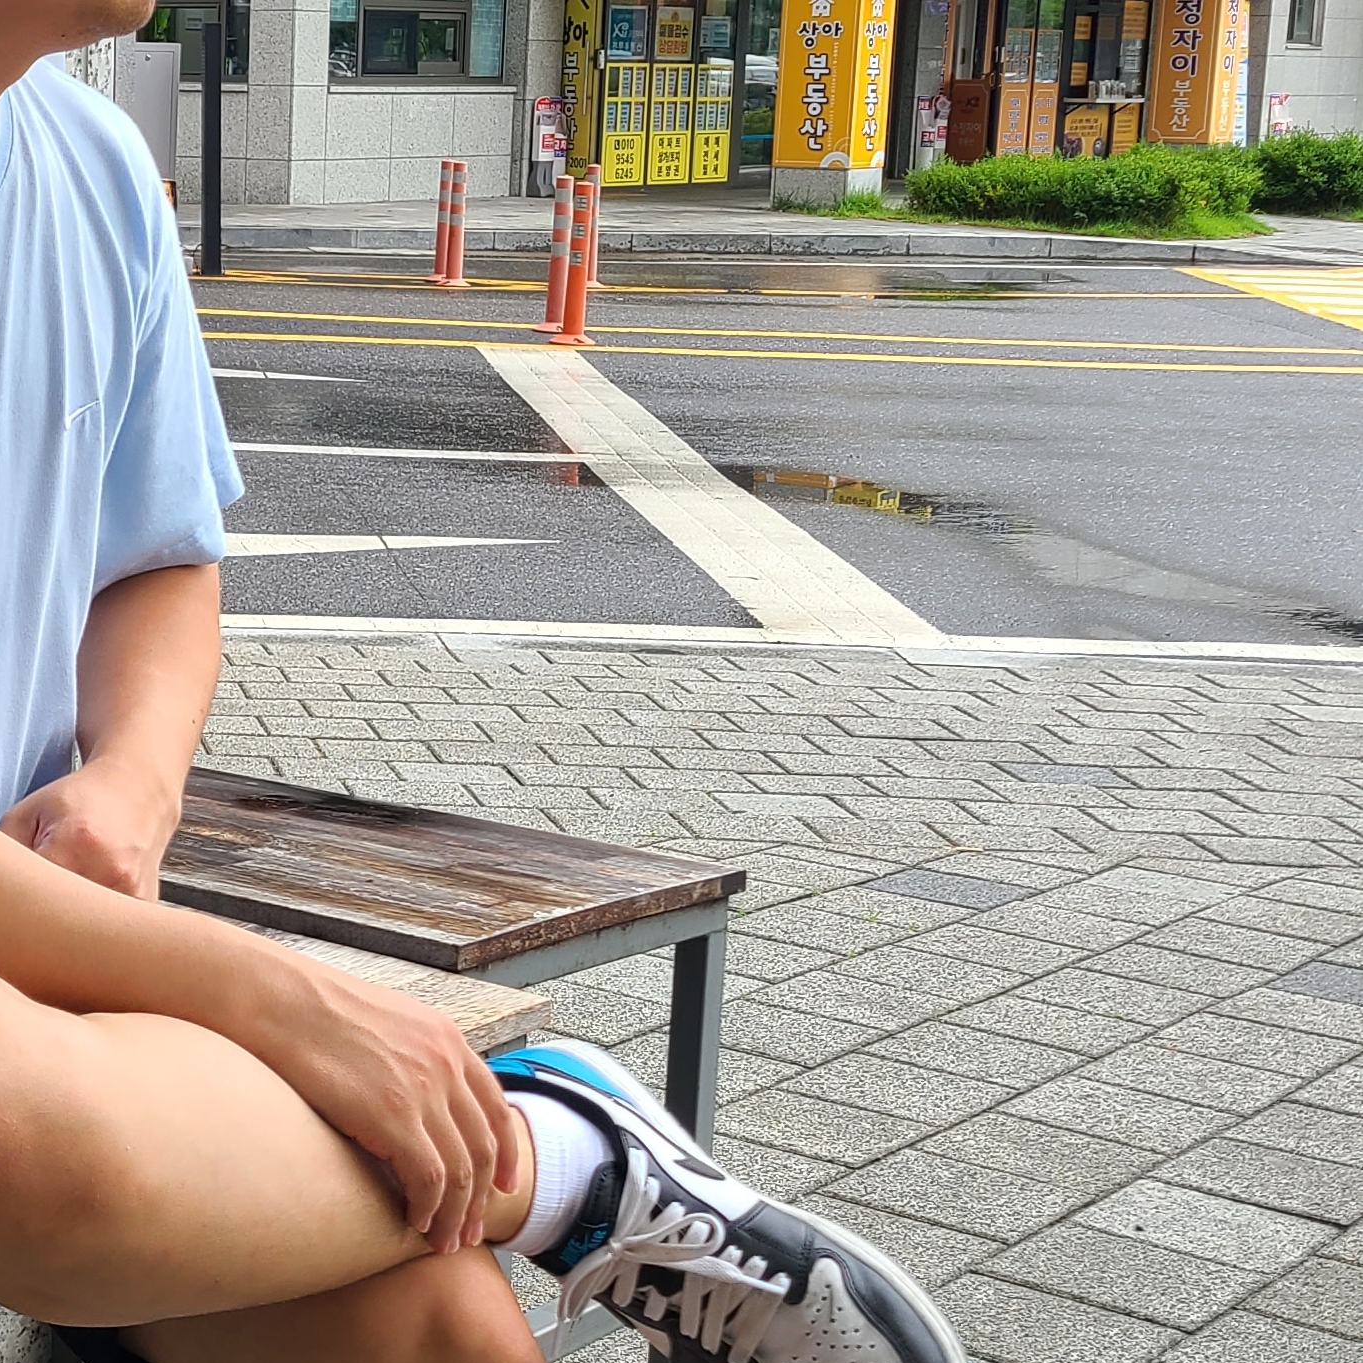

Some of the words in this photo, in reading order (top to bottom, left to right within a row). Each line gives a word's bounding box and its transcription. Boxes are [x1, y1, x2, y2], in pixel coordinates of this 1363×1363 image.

[797, 21, 844, 49] 상아
[865, 21, 888, 50] 상아
[799, 53, 831, 151] 부동산
[862, 53, 881, 151] 부동산
[1169, 80, 1192, 132] 부동산
[621, 138, 635, 150] 010
